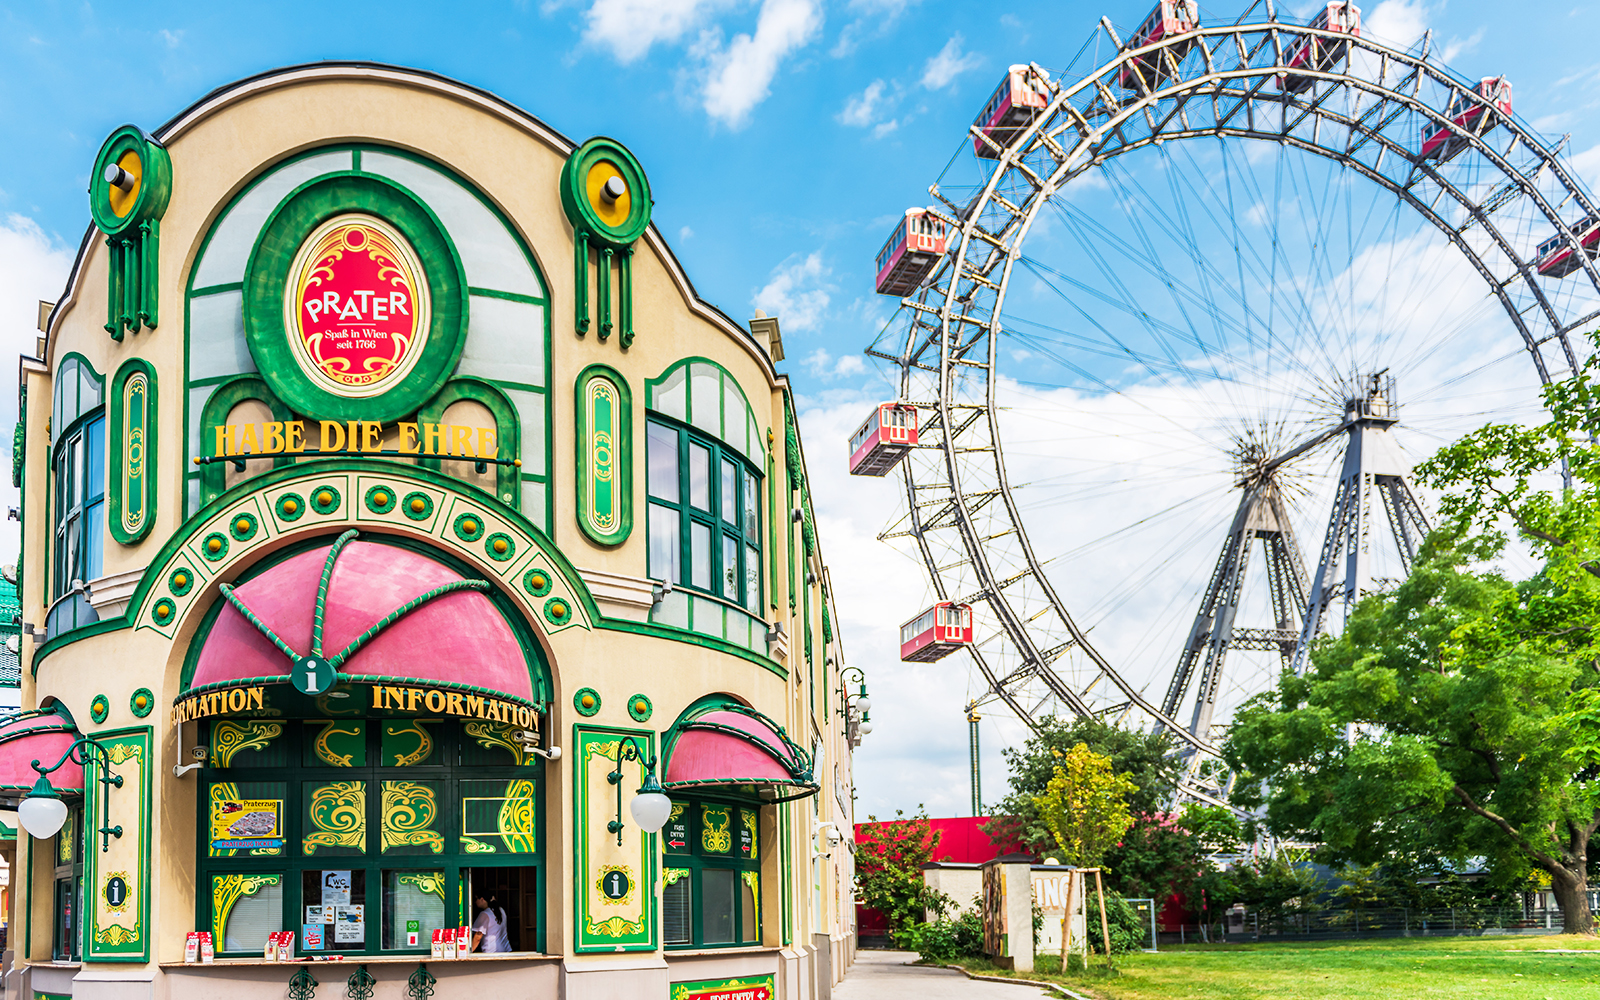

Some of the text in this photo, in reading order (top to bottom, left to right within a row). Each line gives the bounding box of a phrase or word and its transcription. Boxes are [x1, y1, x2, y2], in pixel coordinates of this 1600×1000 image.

[305, 290, 409, 323] PRATER
[324, 329, 388, 341] Spaß in Wien
[336, 340, 376, 349] seit 1766
[214, 420, 499, 460] HABE DIE EHRE
[372, 685, 539, 731] INFORMATION
[243, 800, 276, 808] Praterzug
[221, 840, 254, 848] PRATERZUG
[333, 878, 347, 886] WC
